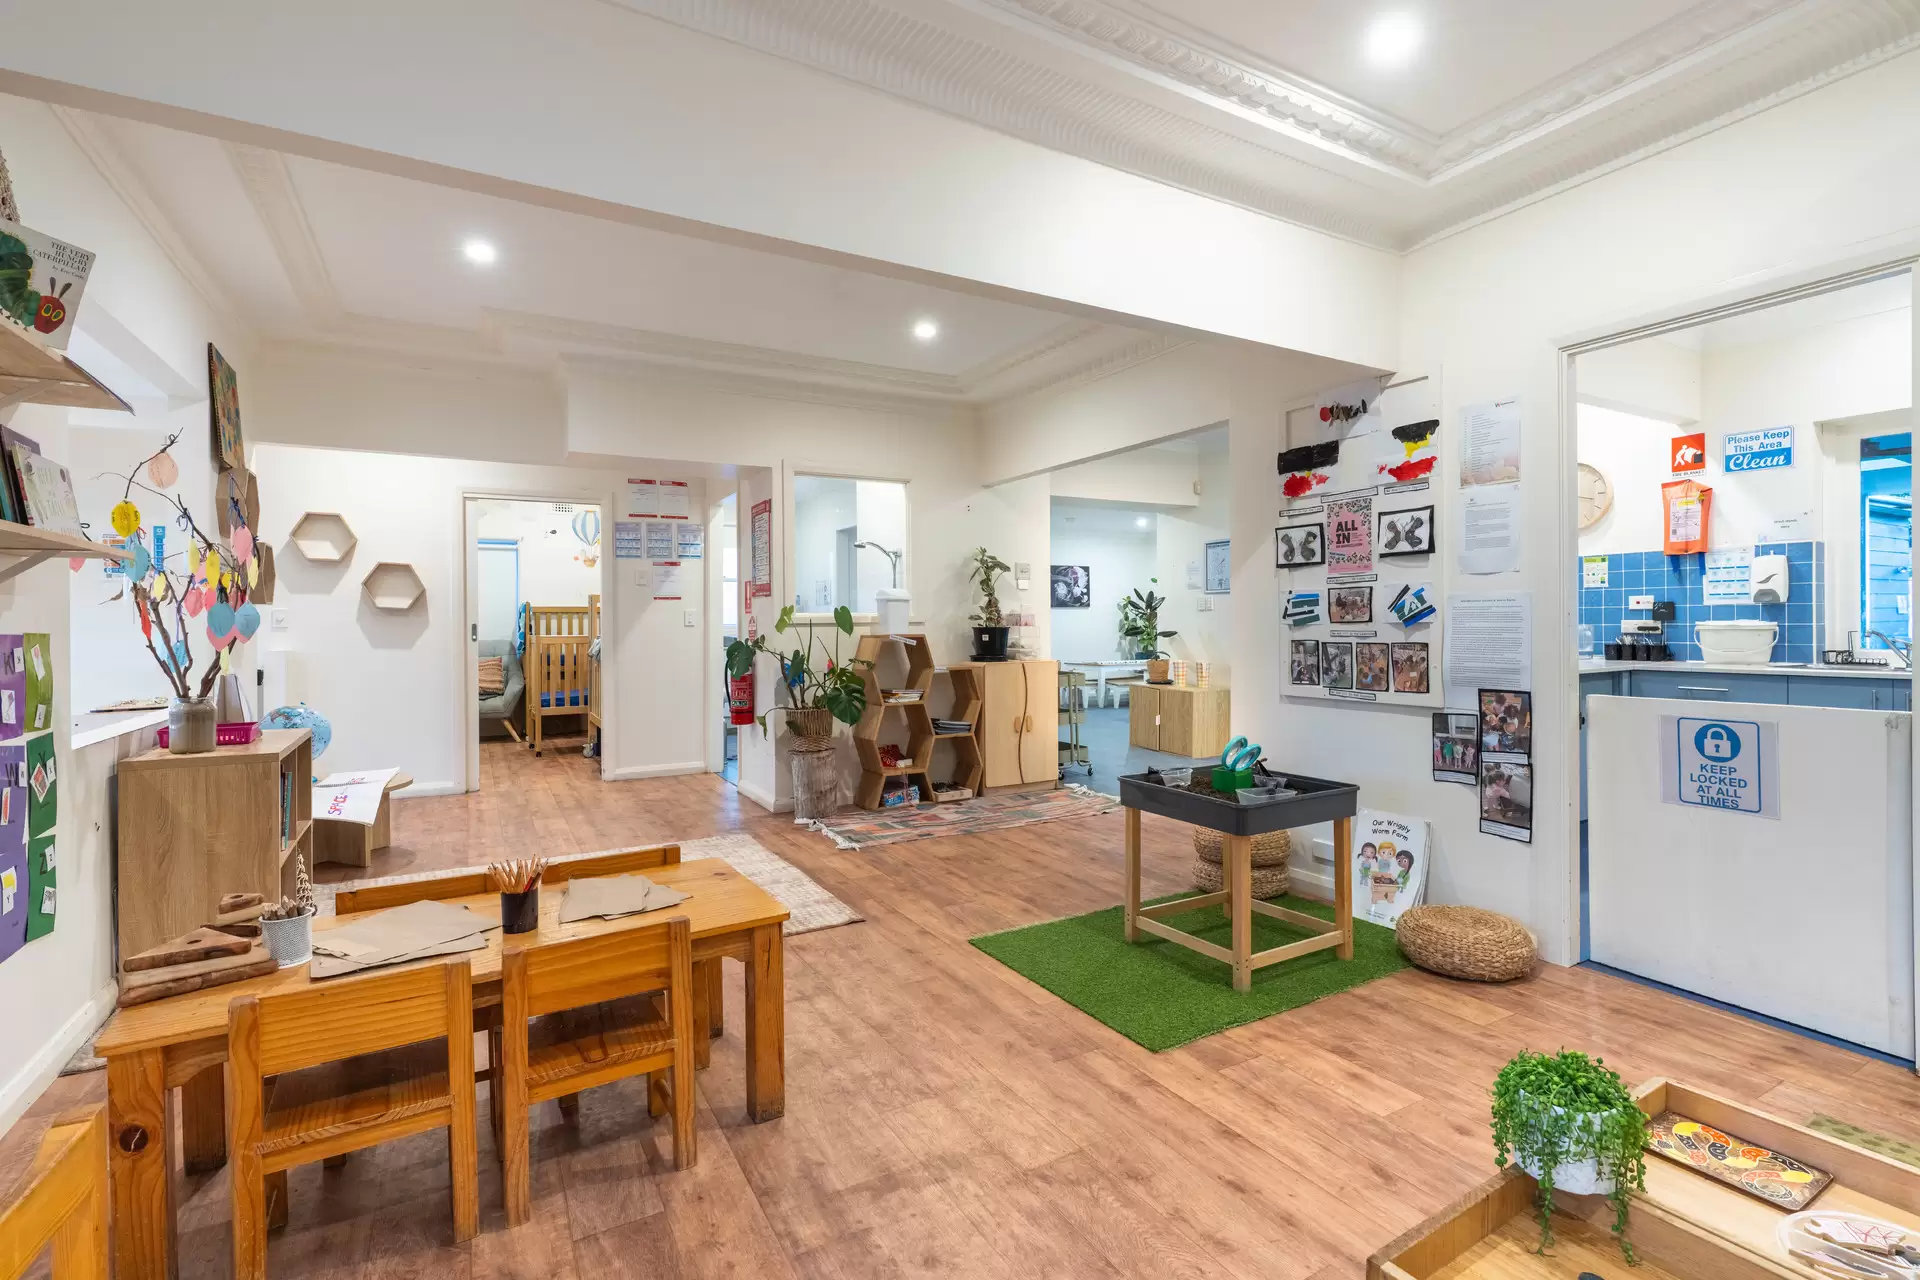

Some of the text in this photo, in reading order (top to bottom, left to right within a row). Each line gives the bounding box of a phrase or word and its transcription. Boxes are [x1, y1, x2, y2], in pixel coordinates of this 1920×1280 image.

[51, 241, 90, 261] THE VERY
[55, 250, 88, 267] HUNGRY
[33, 249, 87, 273] CATERPILLAR
[1727, 430, 1790, 445] Please Keep
[1733, 441, 1782, 453] This Area
[1729, 453, 1786, 470] Clean
[1336, 520, 1358, 533] ALL
[1336, 532, 1351, 545] IN
[1700, 763, 1737, 776] KEEP
[1689, 773, 1748, 788] LOCKED
[1696, 784, 1742, 799] AT ALL
[1698, 794, 1740, 809] TIMES
[1387, 819, 1411, 834] Wriggly
[1391, 829, 1409, 842] Farm
